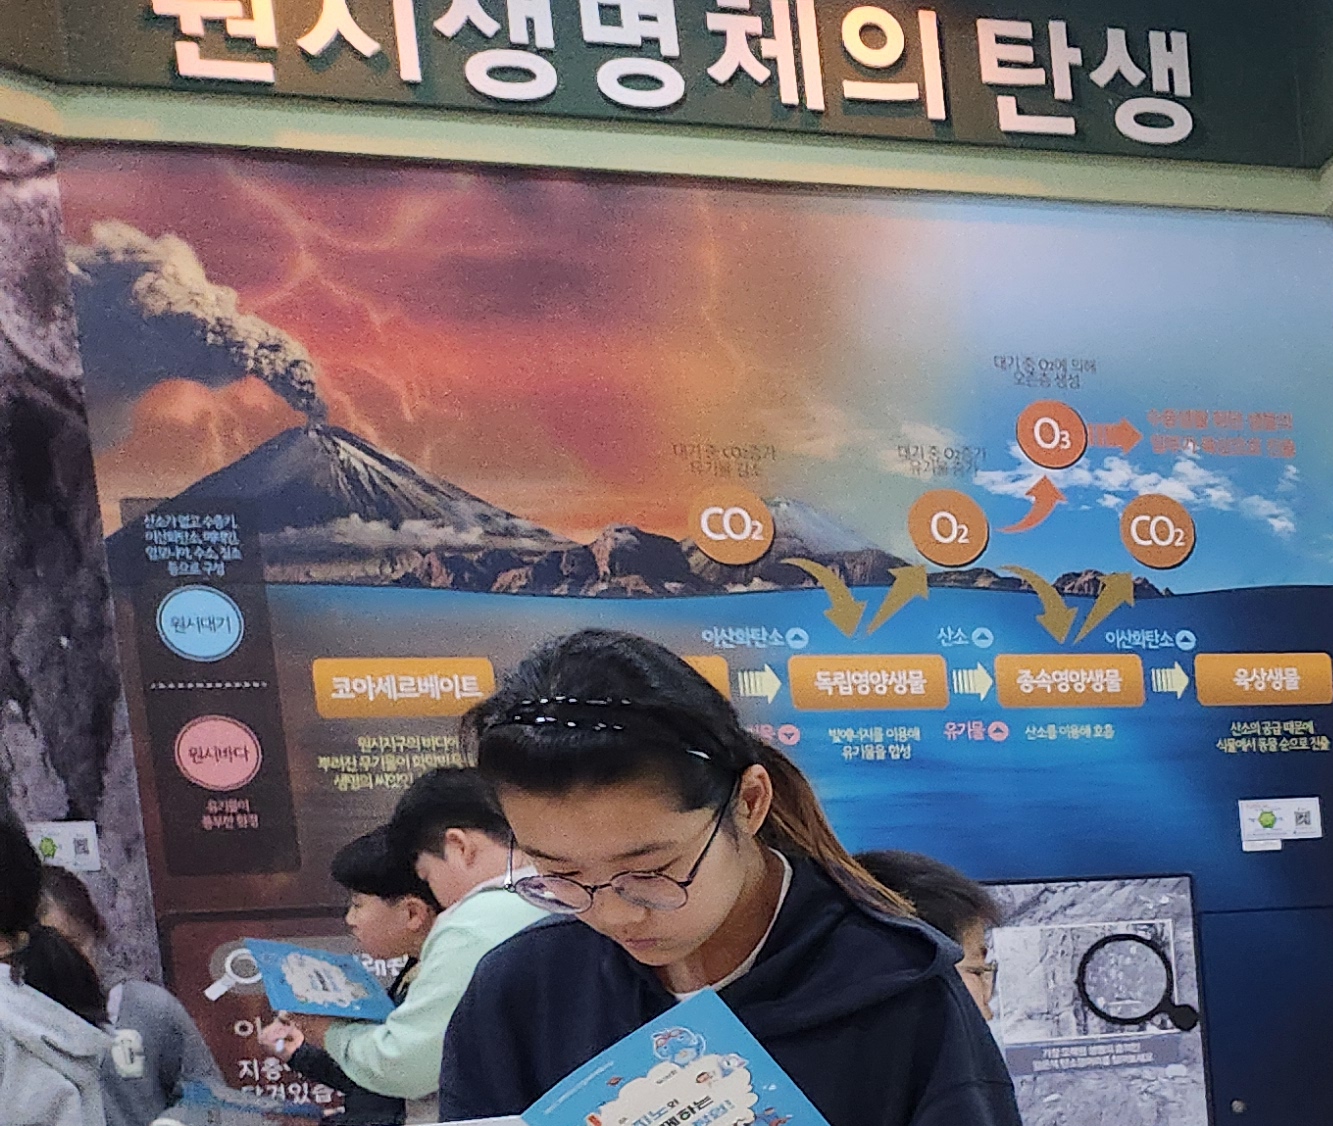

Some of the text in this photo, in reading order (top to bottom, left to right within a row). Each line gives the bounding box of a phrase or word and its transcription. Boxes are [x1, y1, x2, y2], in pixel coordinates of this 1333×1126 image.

[976, 18, 1194, 145] 탄생
[1033, 416, 1071, 450] O3
[700, 506, 764, 541] CO2
[930, 511, 970, 543] O2
[1130, 514, 1187, 547] CO2
[170, 616, 232, 634] 원시대기
[937, 626, 970, 646] 산소
[701, 626, 785, 649] 이산화탄소
[1105, 630, 1175, 650] 이산화탄소
[331, 674, 484, 701] 코아세르베이트
[814, 669, 927, 696] 독립영양생물
[1016, 669, 1123, 693] 종속영양생물
[1234, 667, 1301, 692] 육상생물
[943, 721, 986, 741] 유기물
[1025, 724, 1057, 740] 산소를
[1058, 724, 1091, 740] 이용해
[1230, 721, 1260, 736] 산소의
[1282, 720, 1314, 735] 때문에
[188, 746, 250, 765] 원시바다
[1216, 737, 1256, 754] 식물에서
[1279, 737, 1309, 751] 순으로
